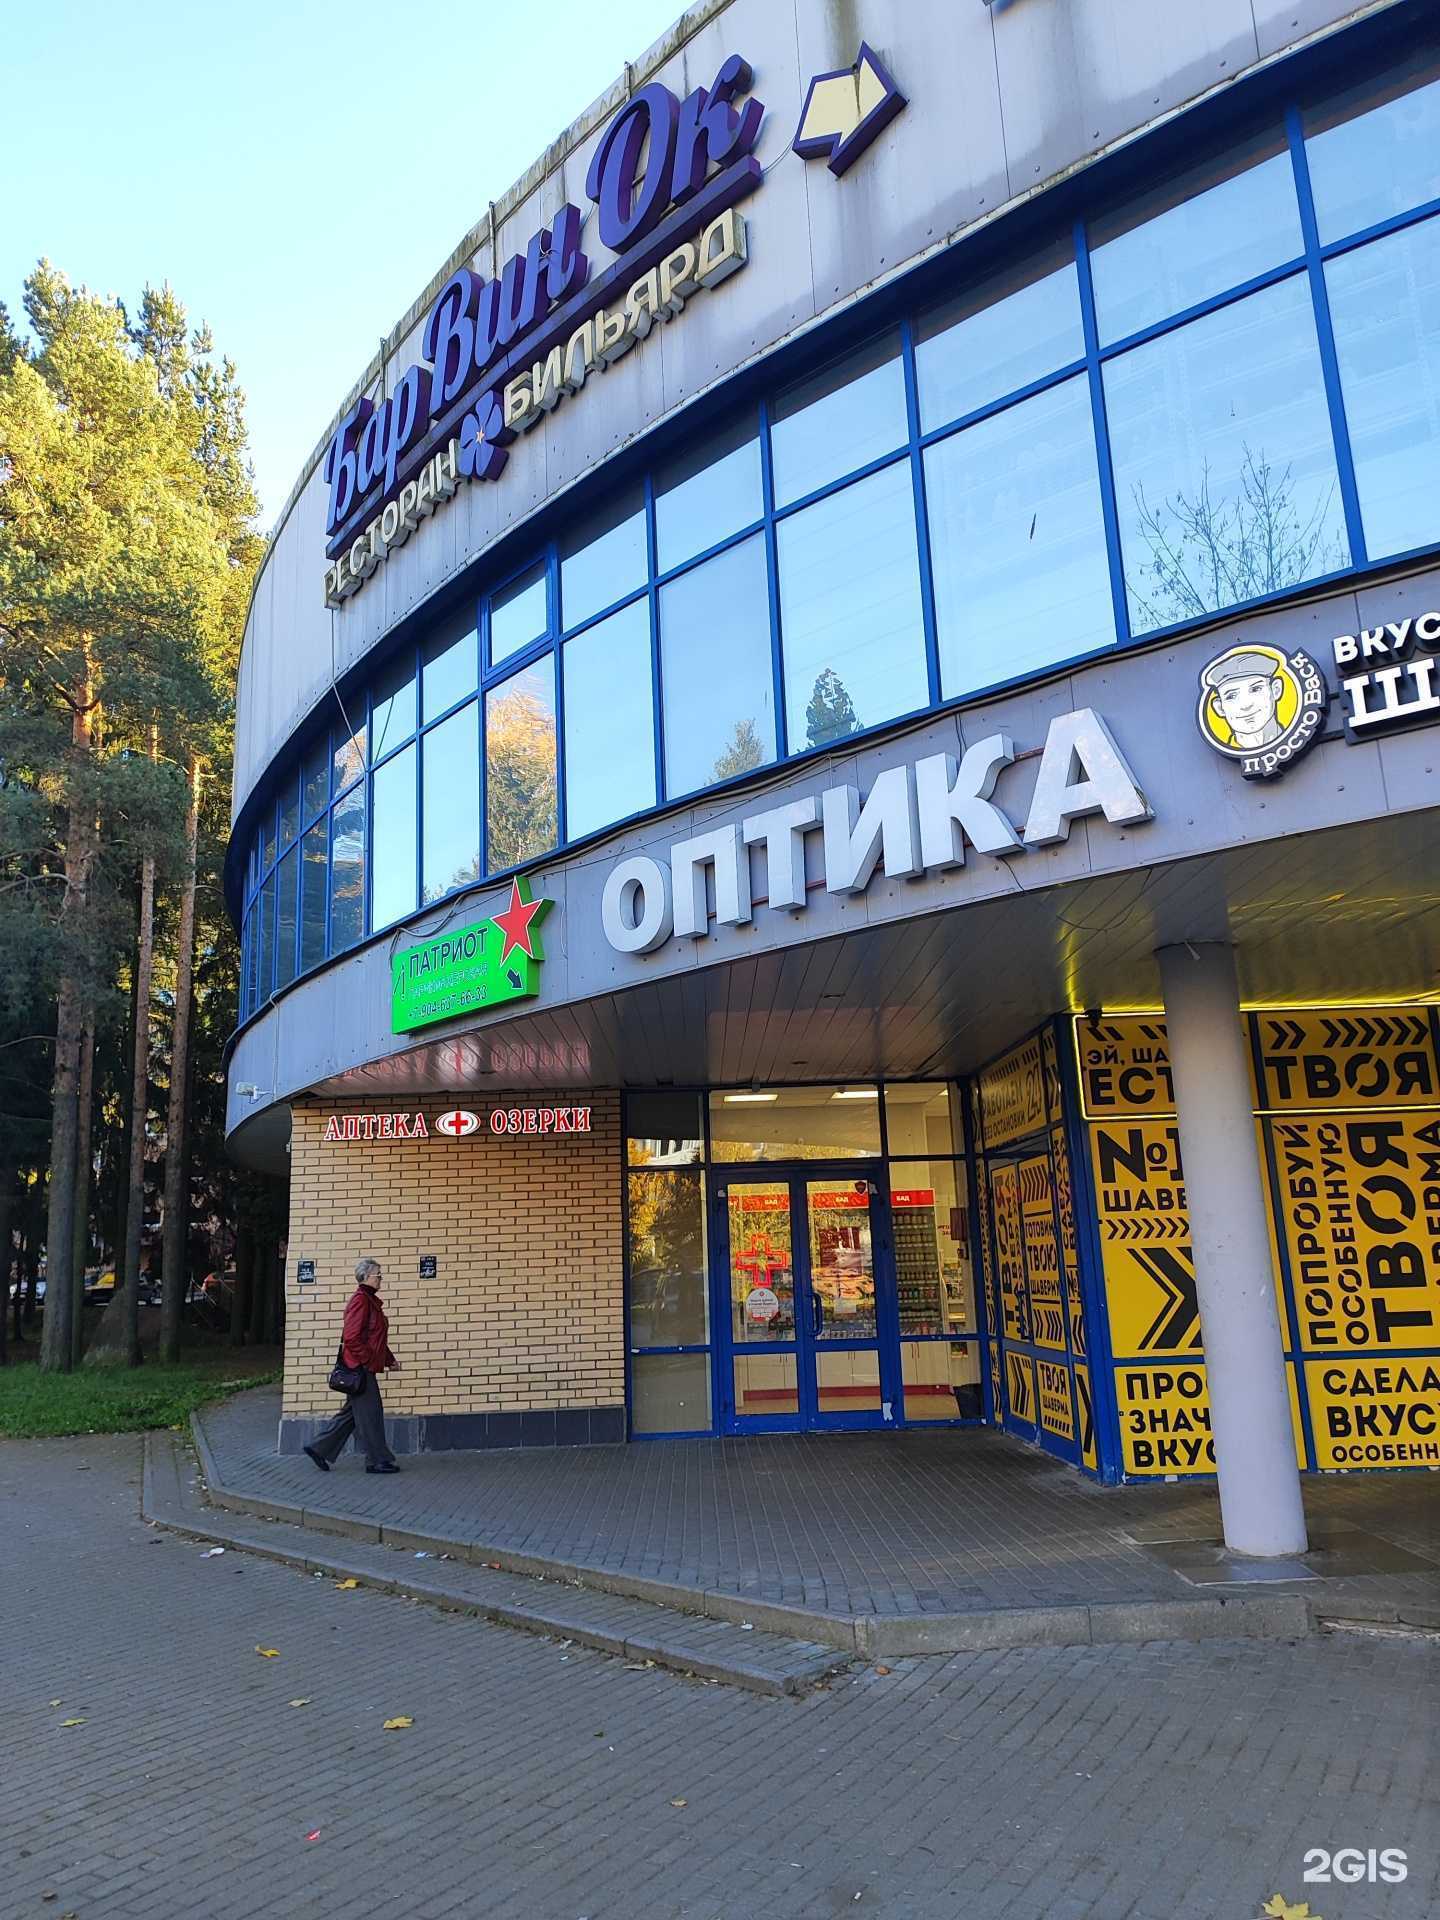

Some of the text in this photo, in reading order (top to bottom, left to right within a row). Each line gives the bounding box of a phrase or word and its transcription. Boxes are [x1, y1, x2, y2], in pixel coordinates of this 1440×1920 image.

[504, 207, 748, 431] БИЛЬЯРД
[323, 437, 466, 609] РЕСТОРАН
[601, 707, 1155, 953] ОПТИКА
[409, 927, 488, 979] ПАТРИОТ
[324, 1107, 591, 1141] АПТЕКА ОЗЕРКИ
[1264, 1051, 1433, 1099] ТВОЯ
[1273, 1124, 1338, 1345] ПОПРОБУЙ
[1317, 1123, 1369, 1345] ОСОБЕННУЮ
[1345, 1121, 1433, 1343] ТВОЯ
[1040, 1364, 1067, 1396] ТВОЯ
[1125, 1371, 1209, 1400] ПРО
